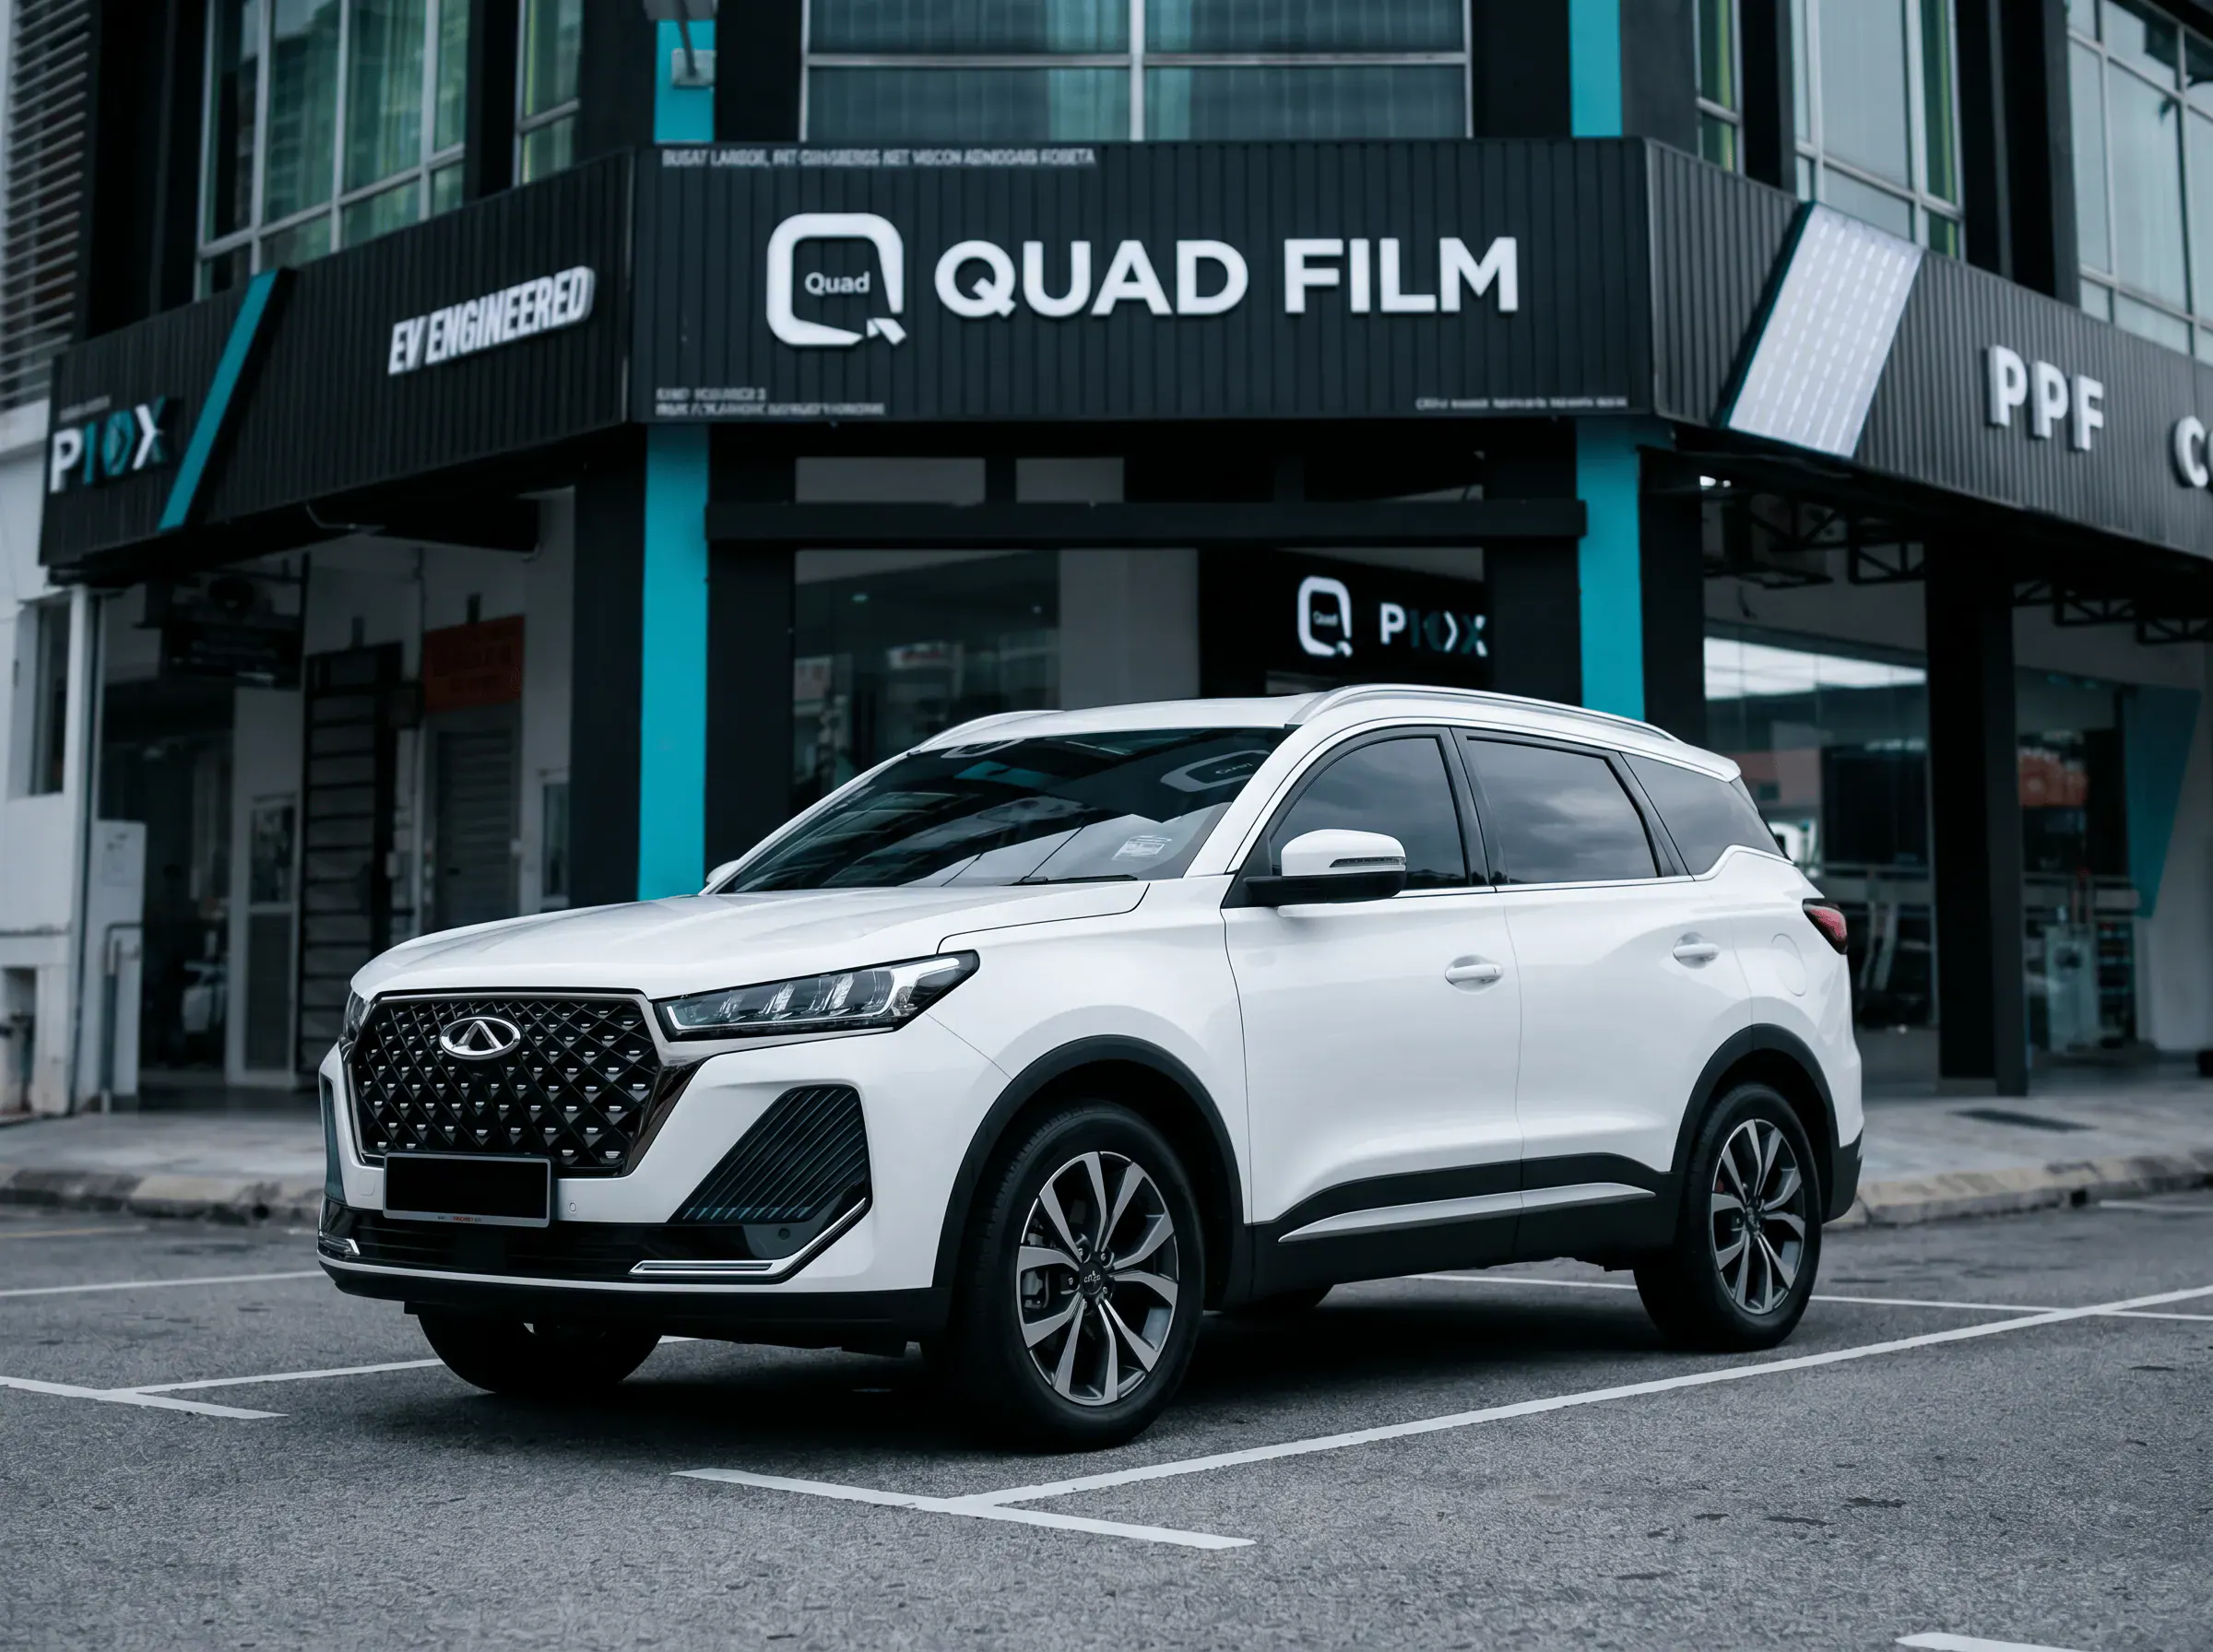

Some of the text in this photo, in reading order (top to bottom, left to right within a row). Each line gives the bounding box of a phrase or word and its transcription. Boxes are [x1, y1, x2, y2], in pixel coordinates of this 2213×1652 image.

[804, 271, 870, 296] Quad
[934, 237, 1519, 317] QUAD FILM
[387, 266, 596, 376] EV ENGINEERED
[1988, 344, 2104, 452] PPF
[2174, 415, 2213, 489] C
